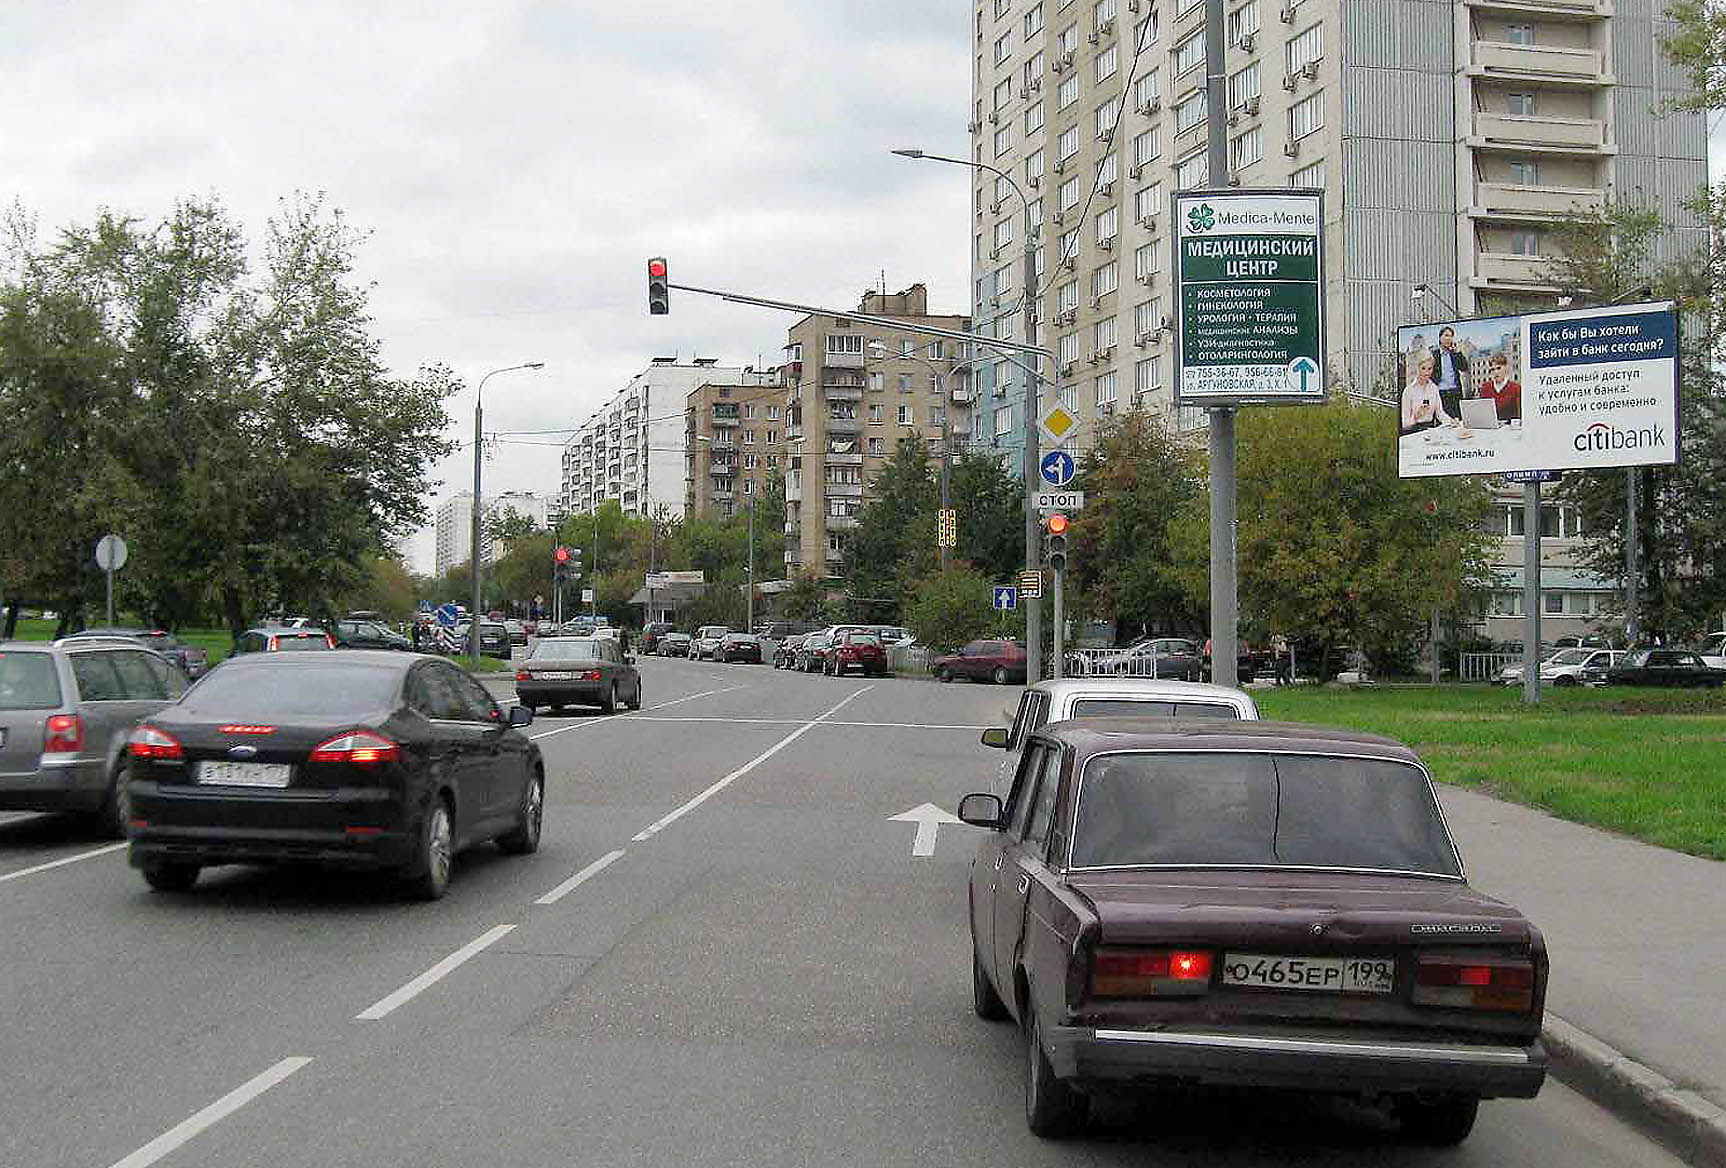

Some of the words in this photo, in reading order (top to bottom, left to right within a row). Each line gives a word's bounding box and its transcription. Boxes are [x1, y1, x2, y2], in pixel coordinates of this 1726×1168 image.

[1218, 211, 1314, 225] Medica-Mente
[1187, 238, 1313, 259] МЕДИЦИНСКИЙ
[1226, 260, 1278, 278] ЦЕНТР
[1196, 288, 1271, 298] КОСМЕТОЛОГИЯ
[1196, 300, 1264, 311] ГИНЕКОЛОГИЯ
[1196, 313, 1246, 323] УРОЛОГИЯ
[1538, 330, 1559, 342] Как
[1561, 328, 1577, 340] бы
[1580, 327, 1597, 339] Вы
[1599, 325, 1640, 337] хотели
[1197, 350, 1288, 360] ОТОЛАРИНГОЛОГИЯ
[1538, 346, 1569, 359] зайти
[1571, 347, 1579, 356] в
[1581, 343, 1609, 356] банк
[1610, 338, 1664, 353] сегодня?
[1539, 372, 1599, 385] Удаленный
[1602, 369, 1640, 381] доступ
[1538, 391, 1545, 399] к
[1547, 387, 1592, 400] услугам
[1538, 402, 1578, 415] удобно
[1580, 402, 1587, 411] и
[1590, 397, 1657, 412] современно
[1574, 423, 1665, 451] citibank
[1425, 449, 1495, 461] www.citibank.ru
[1039, 495, 1077, 506] СТОП
[1232, 959, 1340, 985] О465ЕР
[1347, 962, 1388, 982] 199
